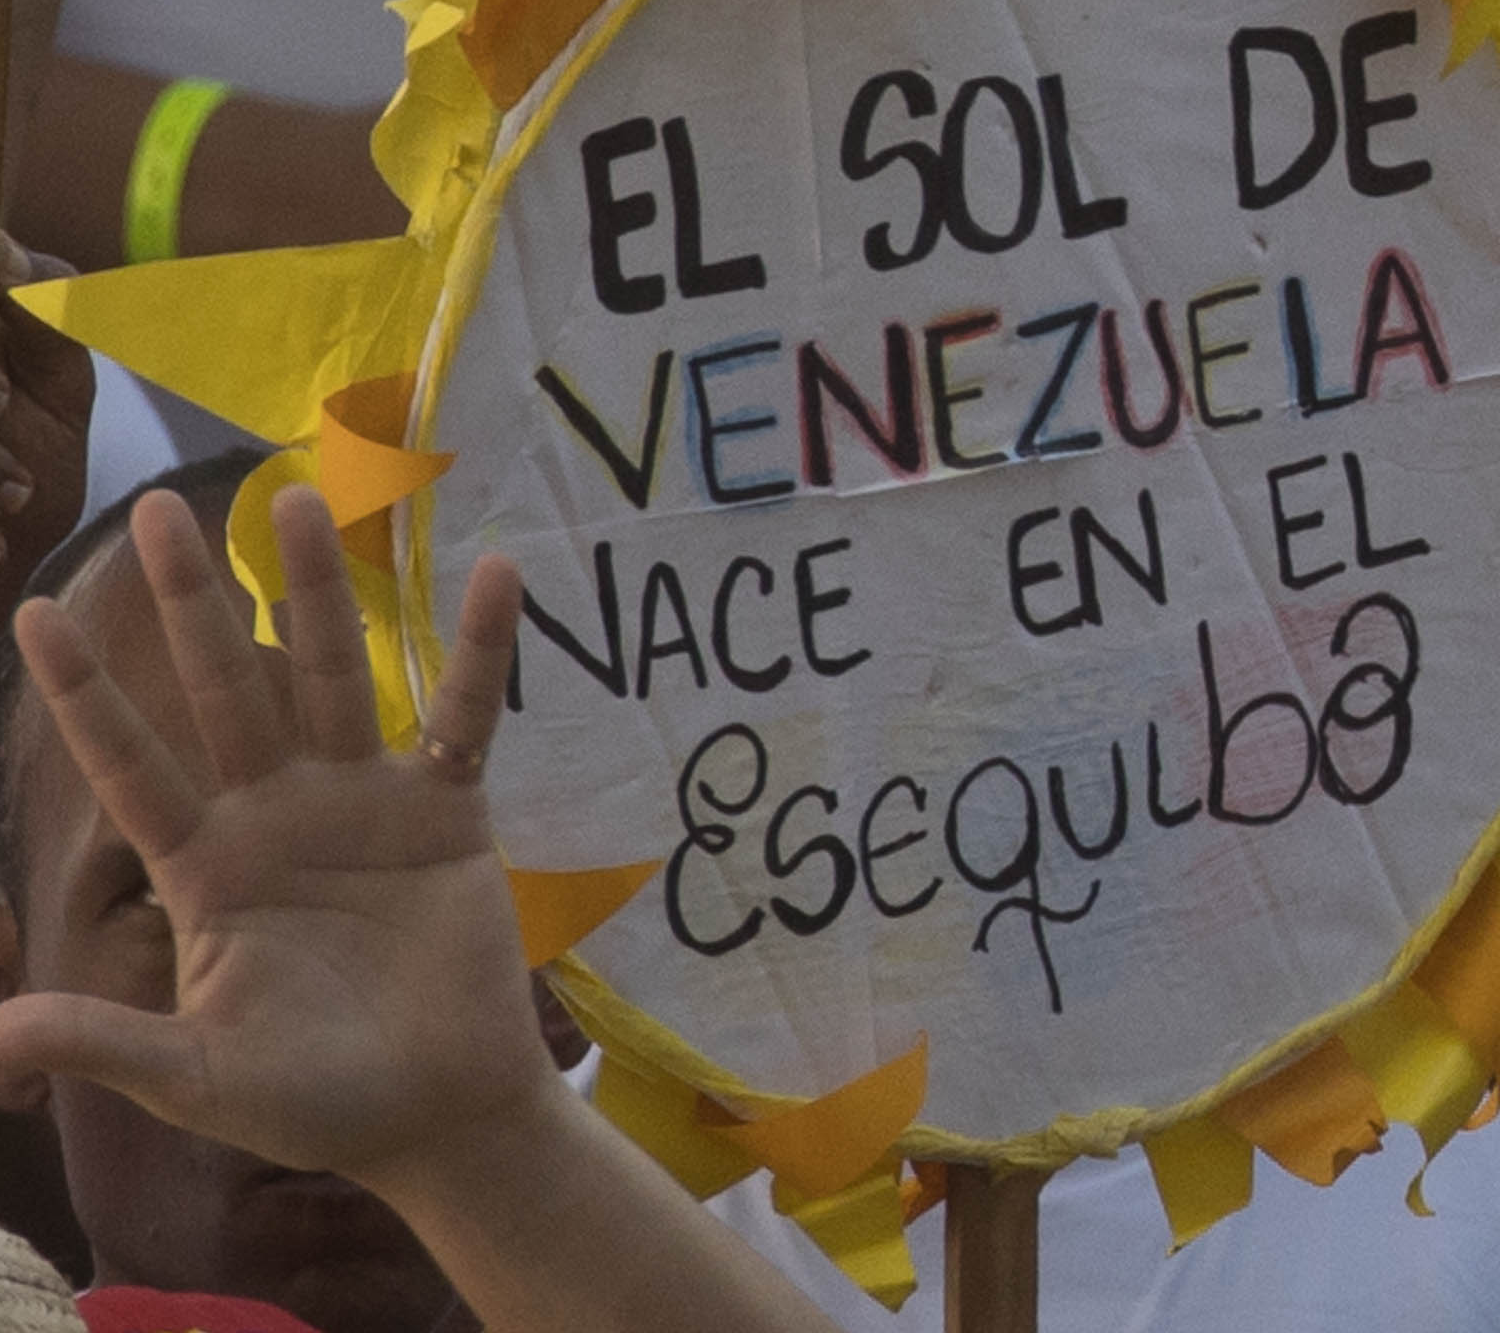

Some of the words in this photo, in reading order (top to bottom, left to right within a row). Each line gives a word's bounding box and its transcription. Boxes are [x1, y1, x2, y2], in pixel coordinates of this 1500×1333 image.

[581, 115, 767, 315] EL
[840, 69, 1129, 272] SOL
[1228, 9, 1433, 211] DE
[535, 247, 1455, 511] VENEZUELA
[503, 537, 872, 714] NACE
[1006, 489, 1168, 637] EN
[1266, 451, 1432, 592] EL
